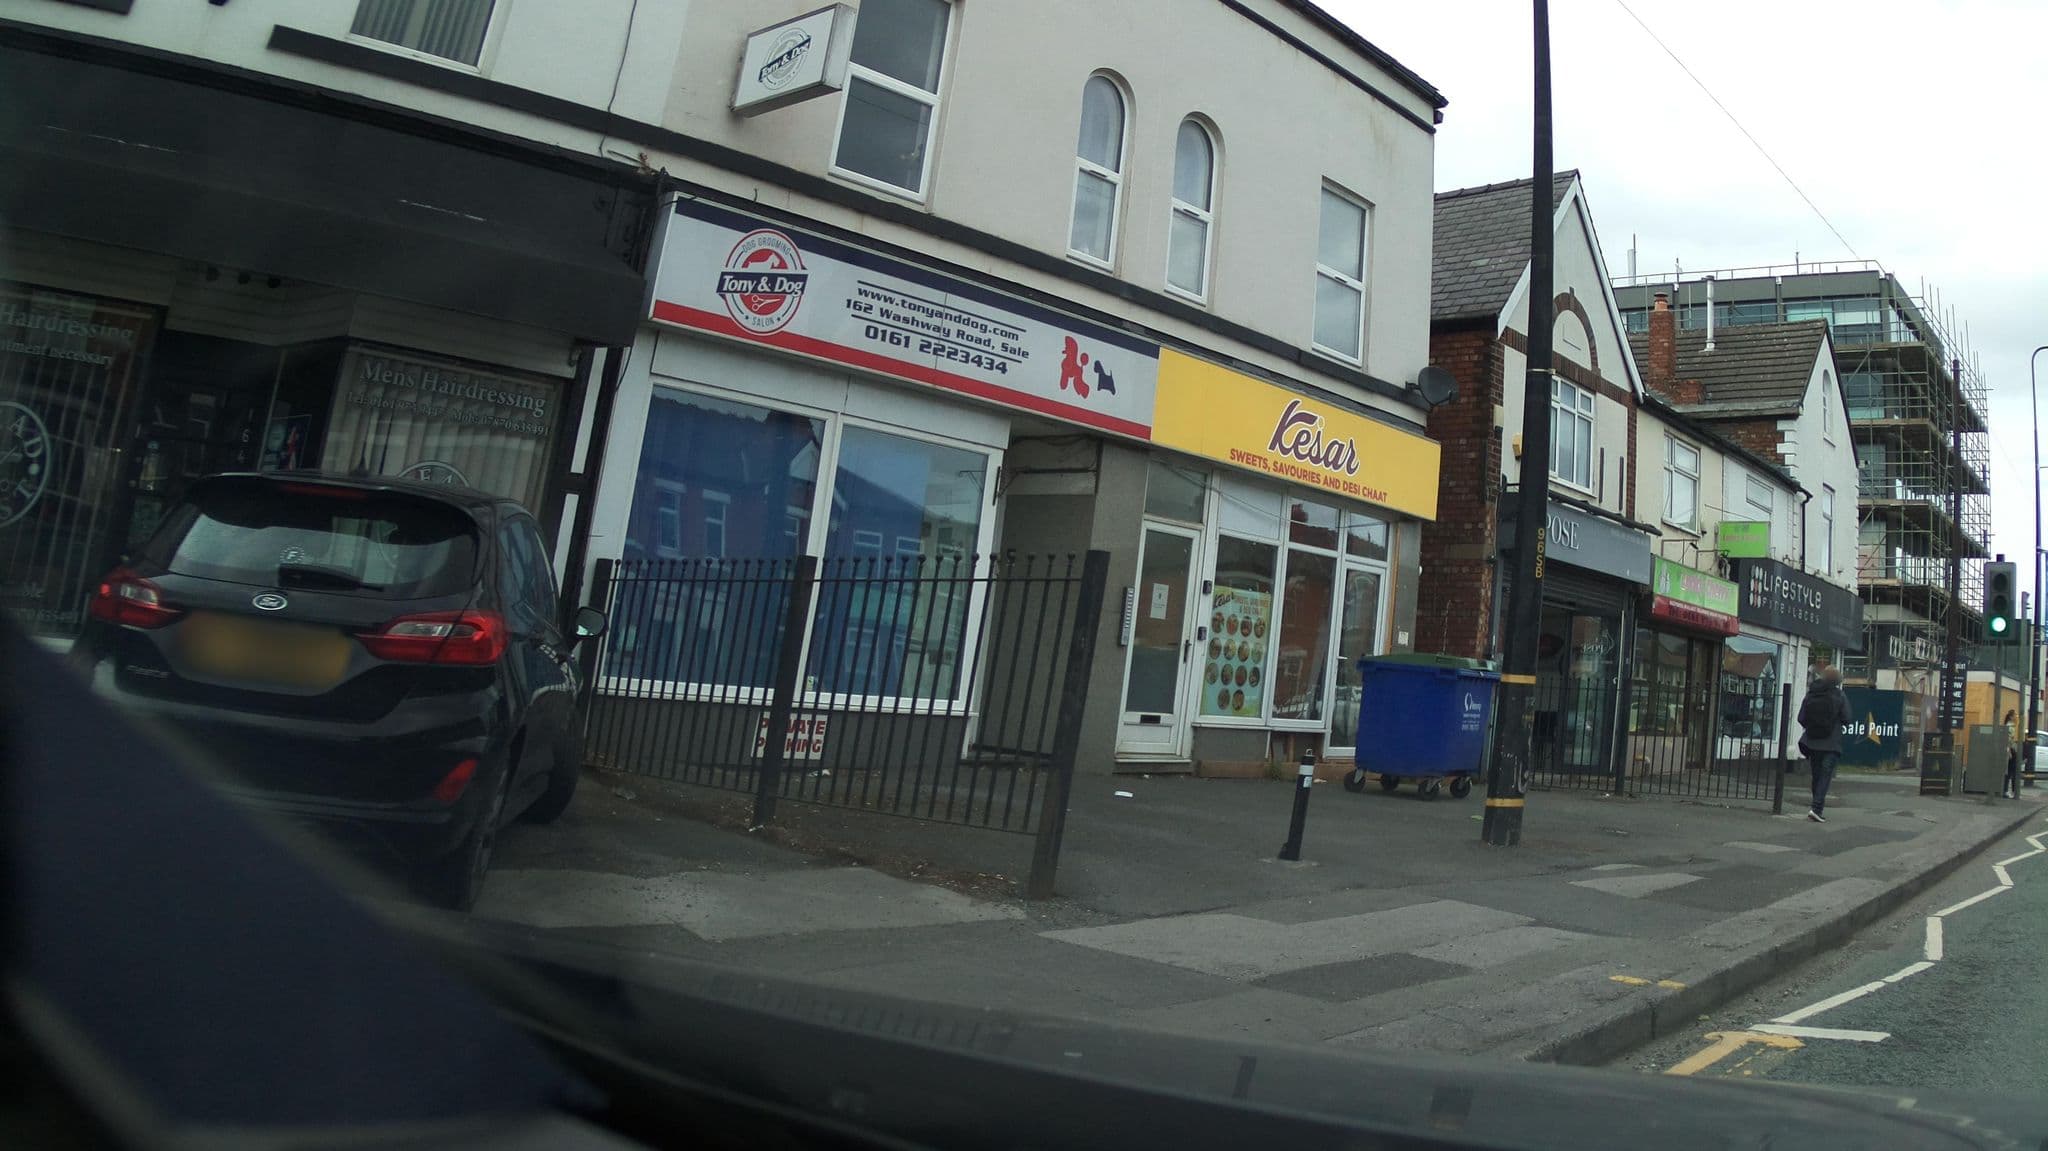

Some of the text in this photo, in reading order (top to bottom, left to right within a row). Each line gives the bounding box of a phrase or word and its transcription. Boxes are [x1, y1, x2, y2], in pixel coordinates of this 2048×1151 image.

[742, 237, 791, 255] DOG GROOMING
[722, 275, 804, 298] Tony & Dog
[751, 316, 775, 328] SALON
[845, 298, 1030, 360] 162 Washway Road, Sale
[857, 287, 1020, 342] www.tonyanddog.com
[864, 324, 1008, 375] 0161 2223434
[360, 359, 547, 418] Mens Hairdressing
[1268, 398, 1360, 476] Kesar
[1229, 448, 1388, 503] SWEETS, SAVOURIES AND DESI CHAAT
[1535, 527, 1545, 578] 96SB
[757, 737, 821, 753] PKING
[760, 719, 826, 735] PVATE
[1868, 721, 1899, 737] Point
